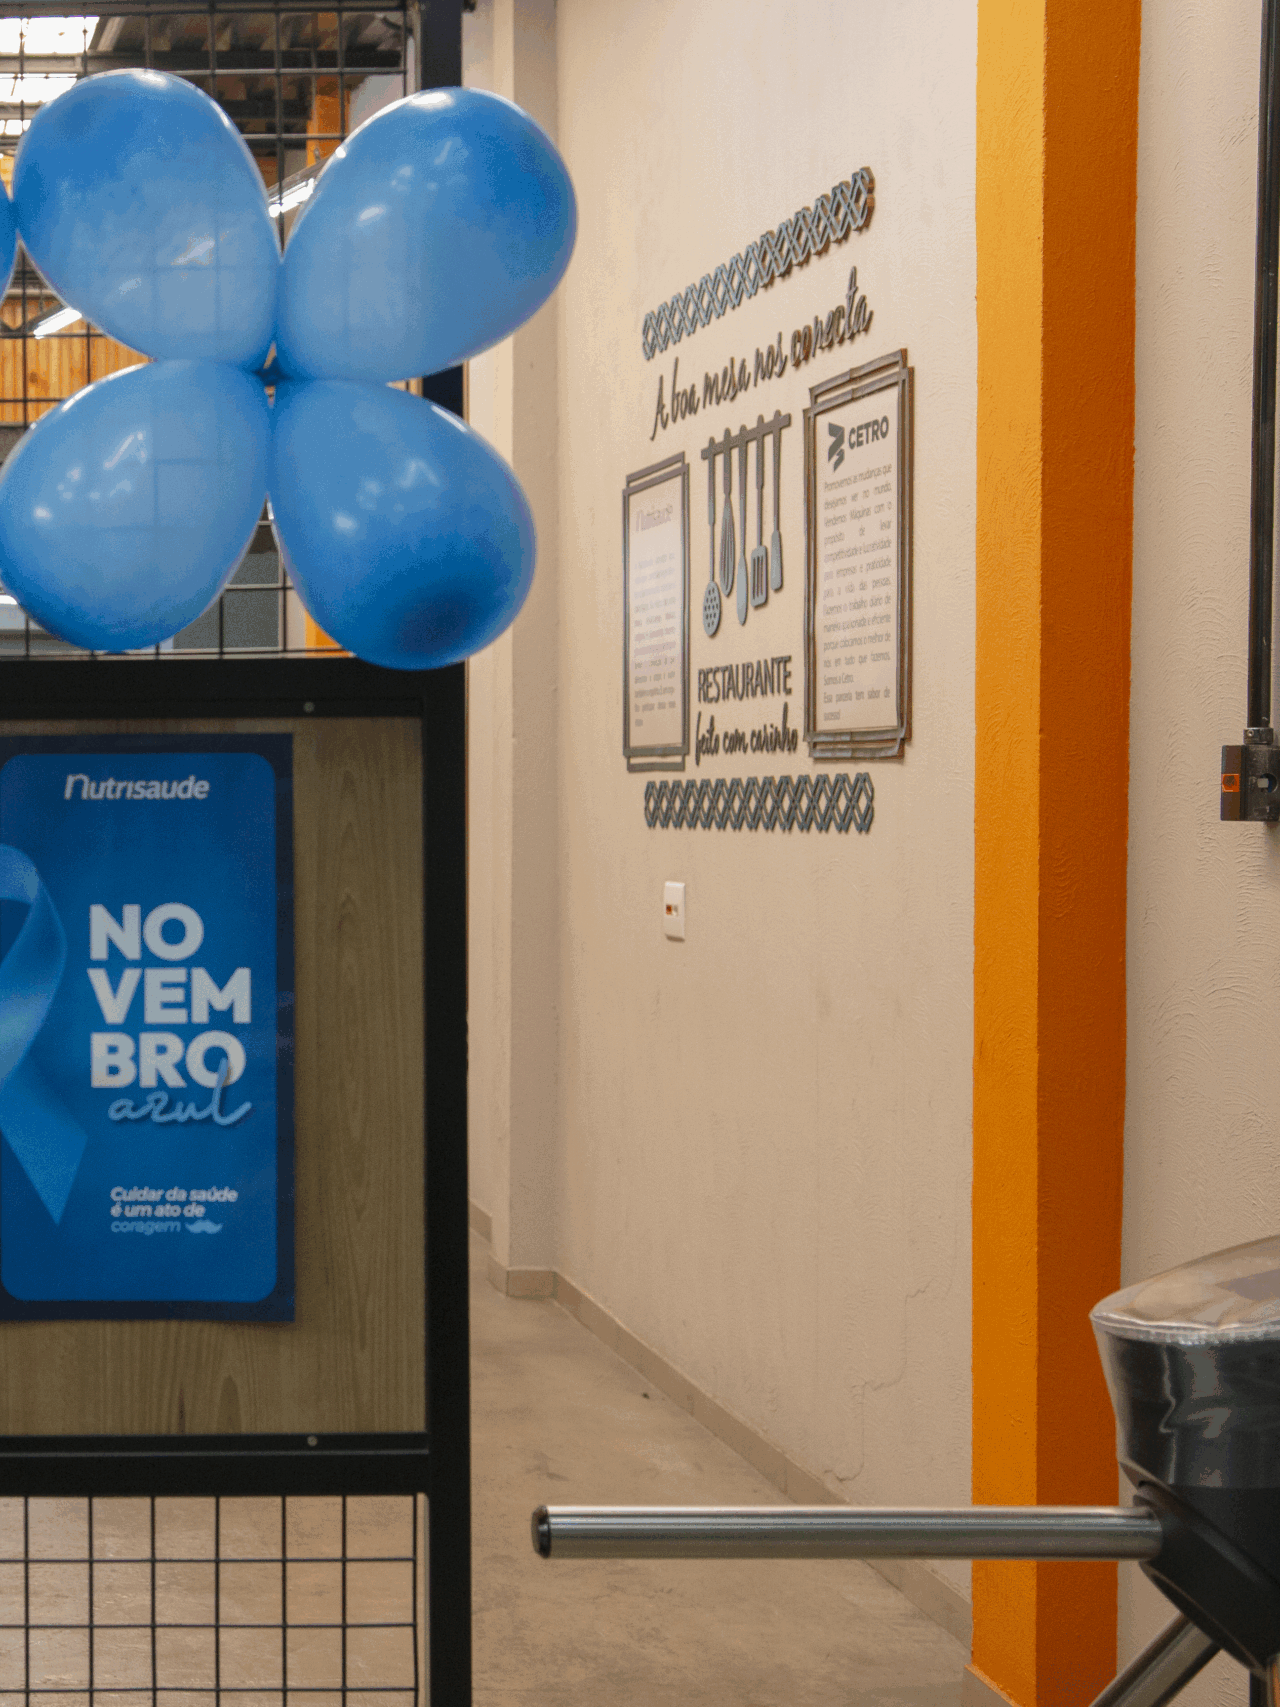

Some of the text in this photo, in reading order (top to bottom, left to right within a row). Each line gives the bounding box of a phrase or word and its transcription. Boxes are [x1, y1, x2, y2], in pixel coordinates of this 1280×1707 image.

[649, 266, 874, 441] A boa mesa nos conecta
[848, 415, 889, 450] CETRO
[698, 655, 792, 703] RESTAURANTE
[695, 701, 799, 767] feito com carinho
[89, 902, 205, 962] NO
[86, 966, 252, 1025] VEM
[90, 1030, 247, 1089] BRO
[107, 1056, 253, 1126] azul
[109, 1185, 239, 1202] Cuidar da saúde
[109, 1201, 207, 1218] é um ato de
[110, 1220, 182, 1235] coragem
